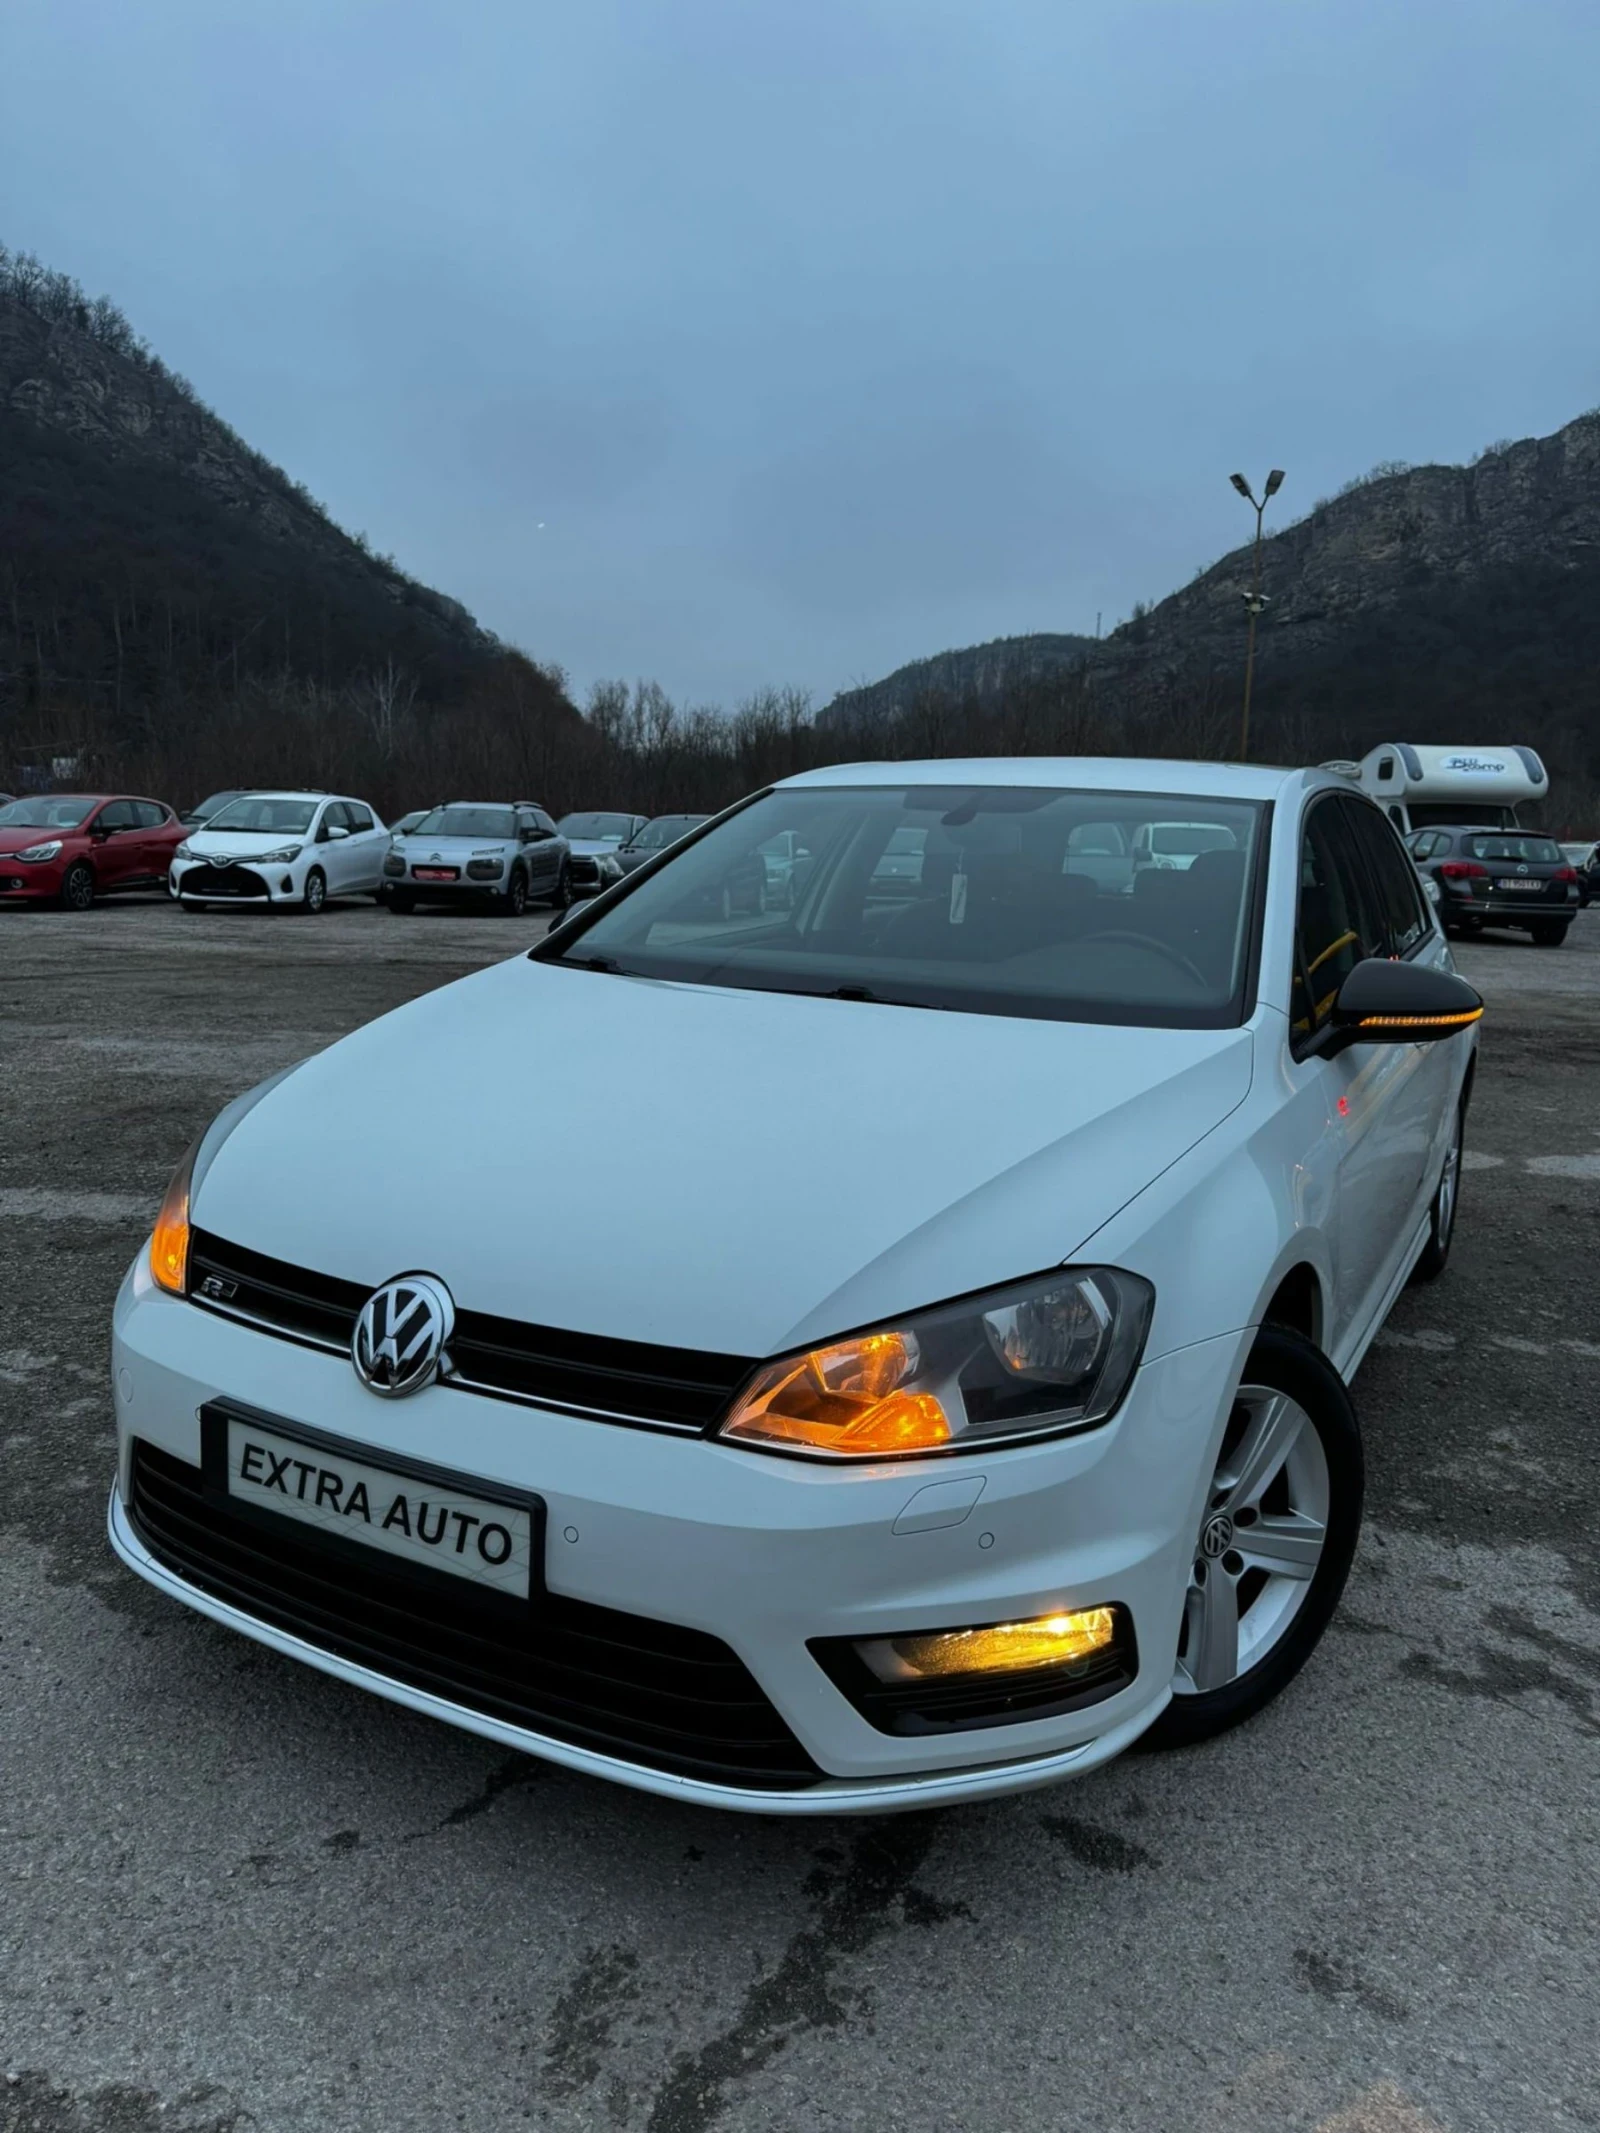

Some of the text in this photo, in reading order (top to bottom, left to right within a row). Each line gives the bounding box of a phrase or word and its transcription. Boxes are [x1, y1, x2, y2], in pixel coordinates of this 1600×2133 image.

[356, 1283, 440, 1393] VW
[240, 1442, 513, 1566] EXTRA AUTO
